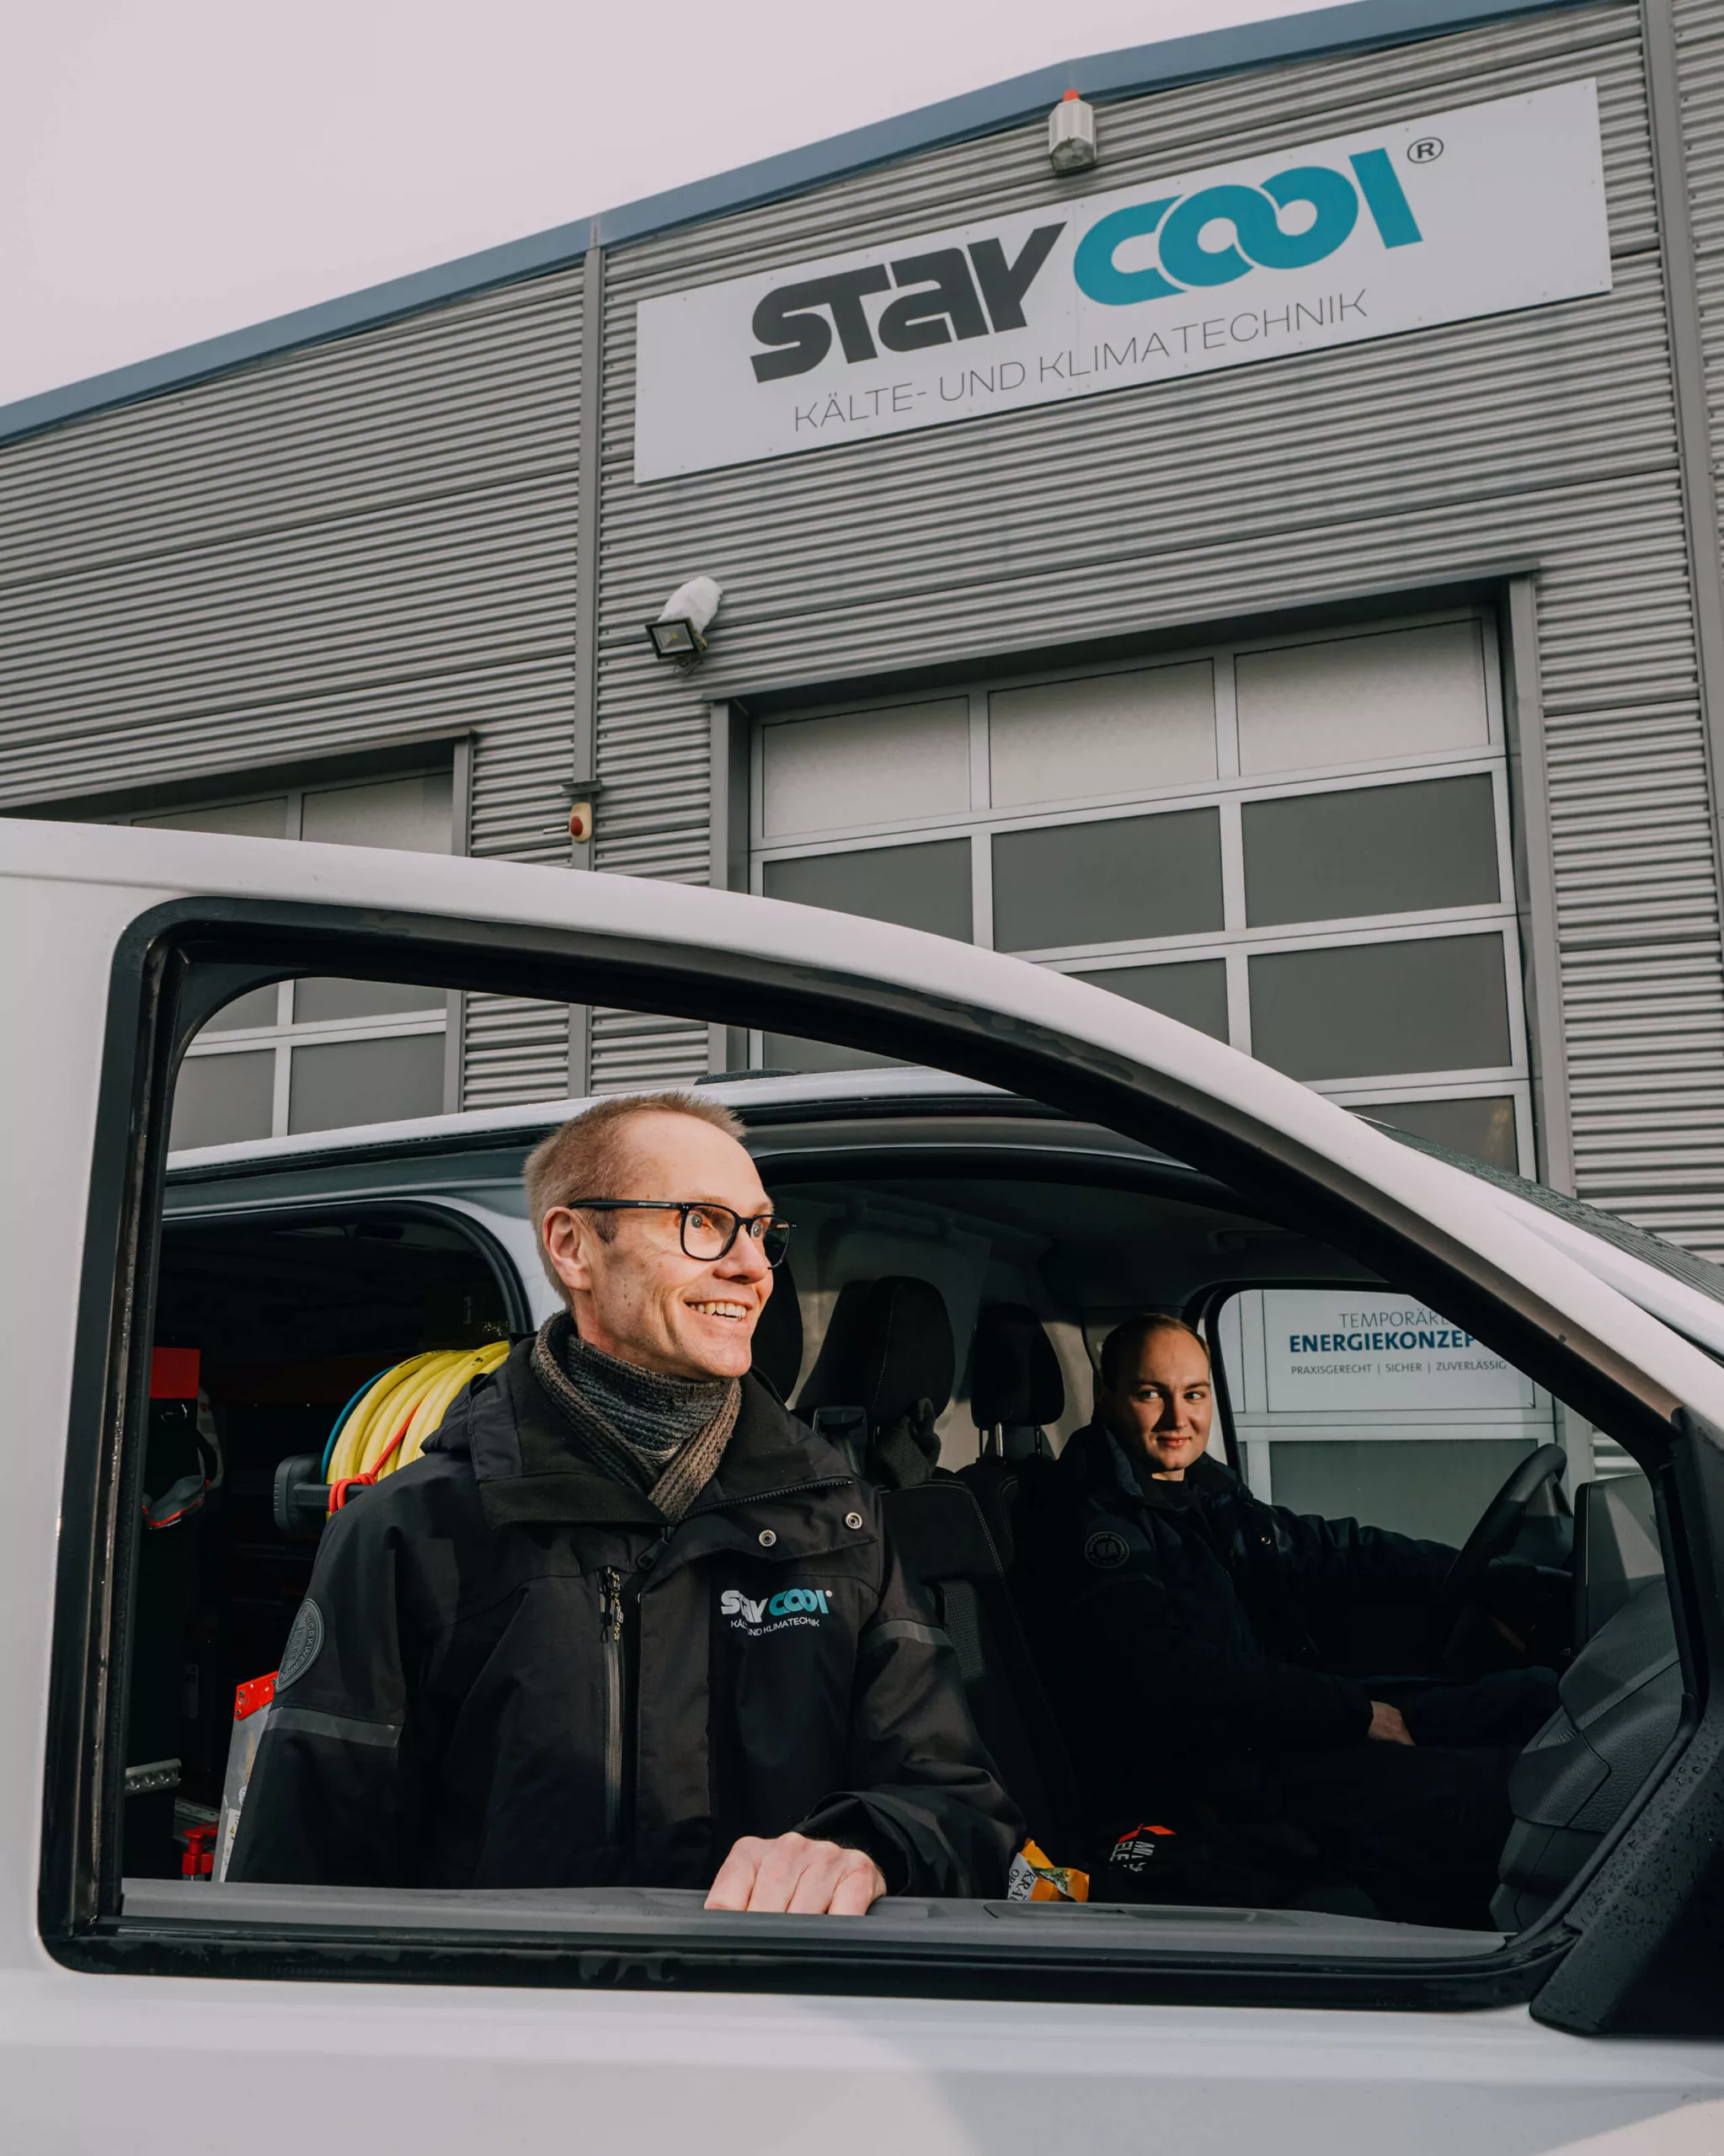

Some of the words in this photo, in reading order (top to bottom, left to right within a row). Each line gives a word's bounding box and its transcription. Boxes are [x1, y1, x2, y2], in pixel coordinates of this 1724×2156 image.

[795, 382, 927, 432] KÄLTE-
[939, 361, 1026, 402] UND
[1039, 288, 1368, 383] KLIMATECHNIK
[1291, 1364, 1372, 1374] PRAXISGERECHT
[1385, 1363, 1422, 1373] SICHER
[1436, 1359, 1507, 1371] ZUVERLÄSSIG
